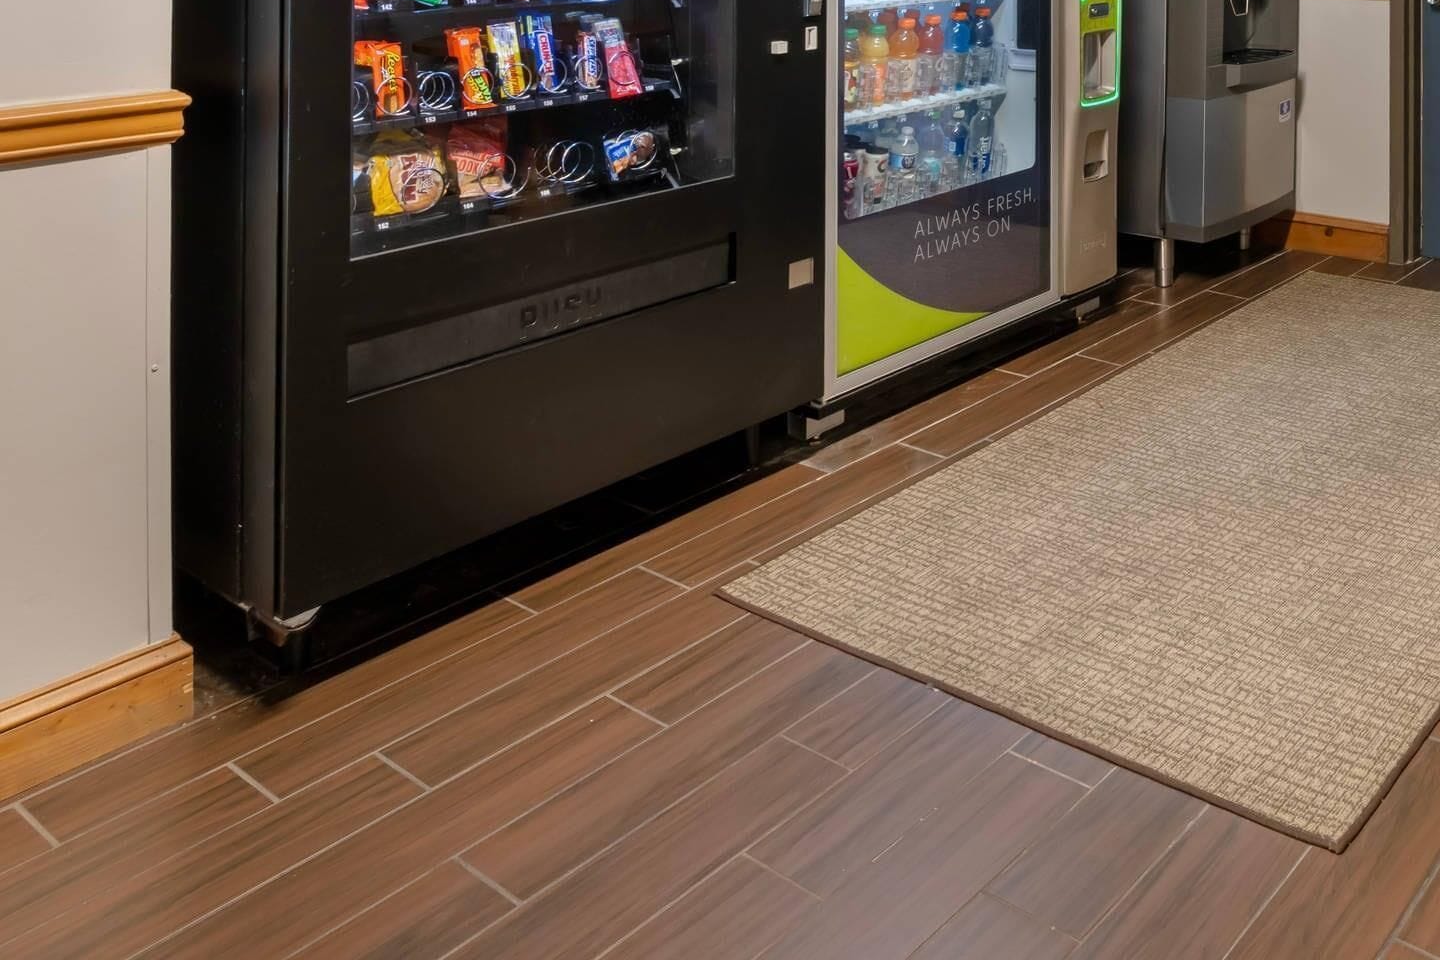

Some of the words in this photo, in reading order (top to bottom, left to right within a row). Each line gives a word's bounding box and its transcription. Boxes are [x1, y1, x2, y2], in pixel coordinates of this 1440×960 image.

[538, 34, 555, 73] CRUNCH
[914, 203, 981, 239] ALWAYS
[987, 187, 1037, 216] FRESH.
[914, 225, 981, 264] ALWAYS
[987, 215, 1011, 238] ON
